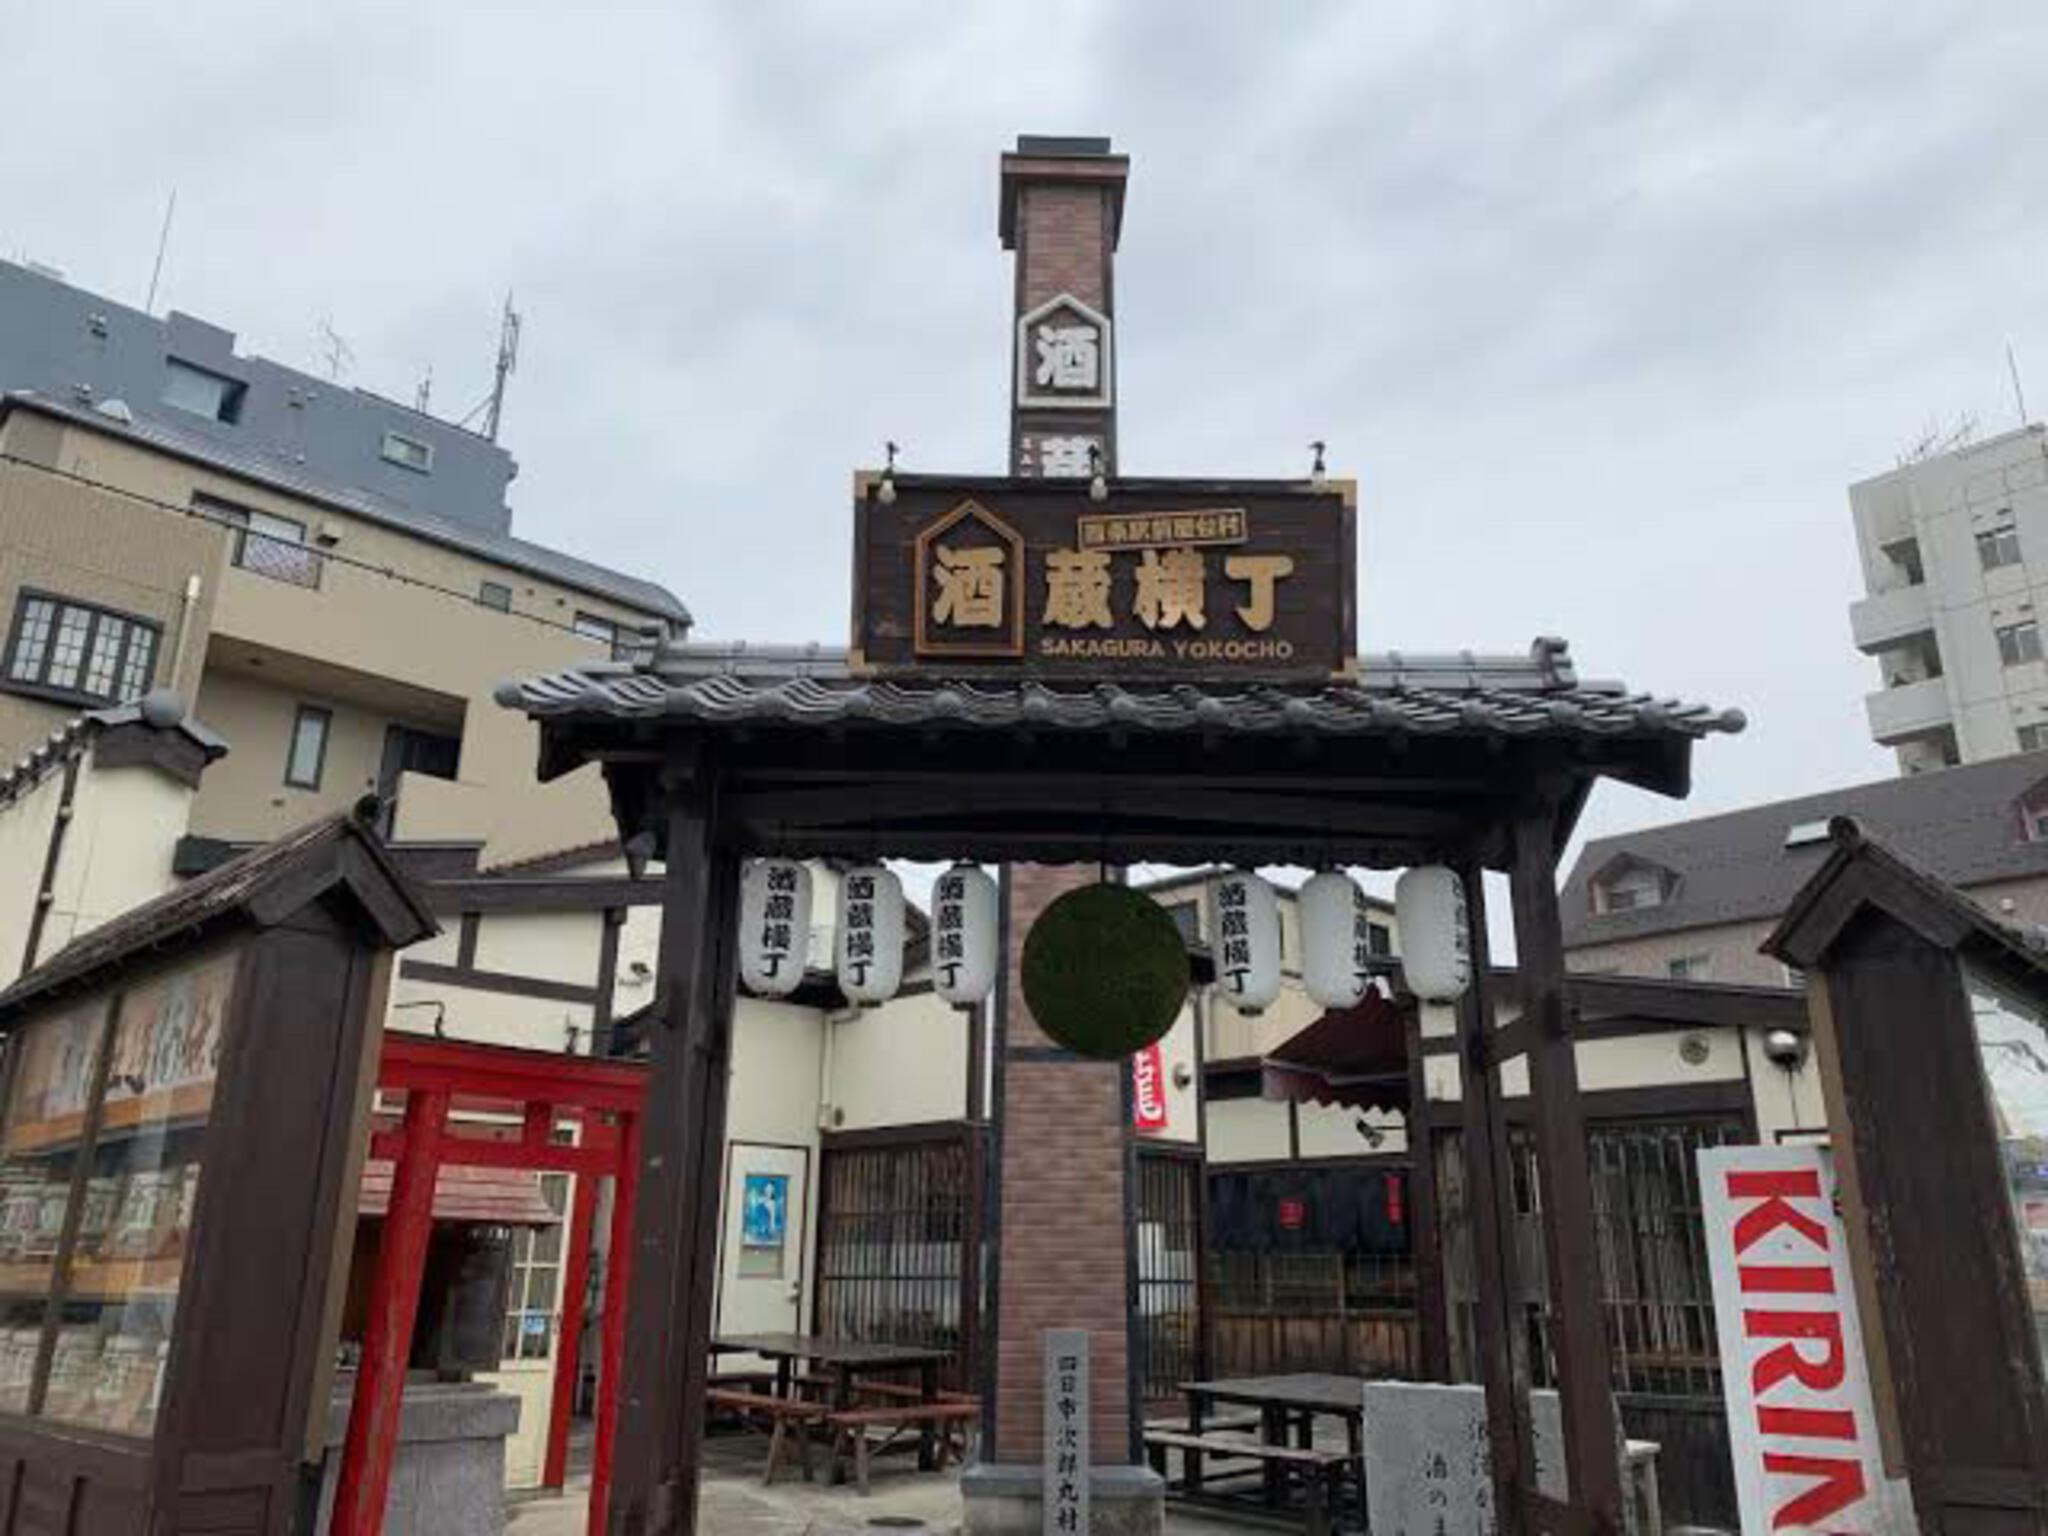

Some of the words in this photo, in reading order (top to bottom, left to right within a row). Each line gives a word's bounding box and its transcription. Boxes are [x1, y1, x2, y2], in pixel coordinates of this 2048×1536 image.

[931, 543, 1294, 630] 酒蔵横丁
[1040, 638, 1165, 659] SAKAGURA
[1173, 639, 1294, 661] YOKOCHO
[1725, 1170, 1867, 1536] KIRIN
